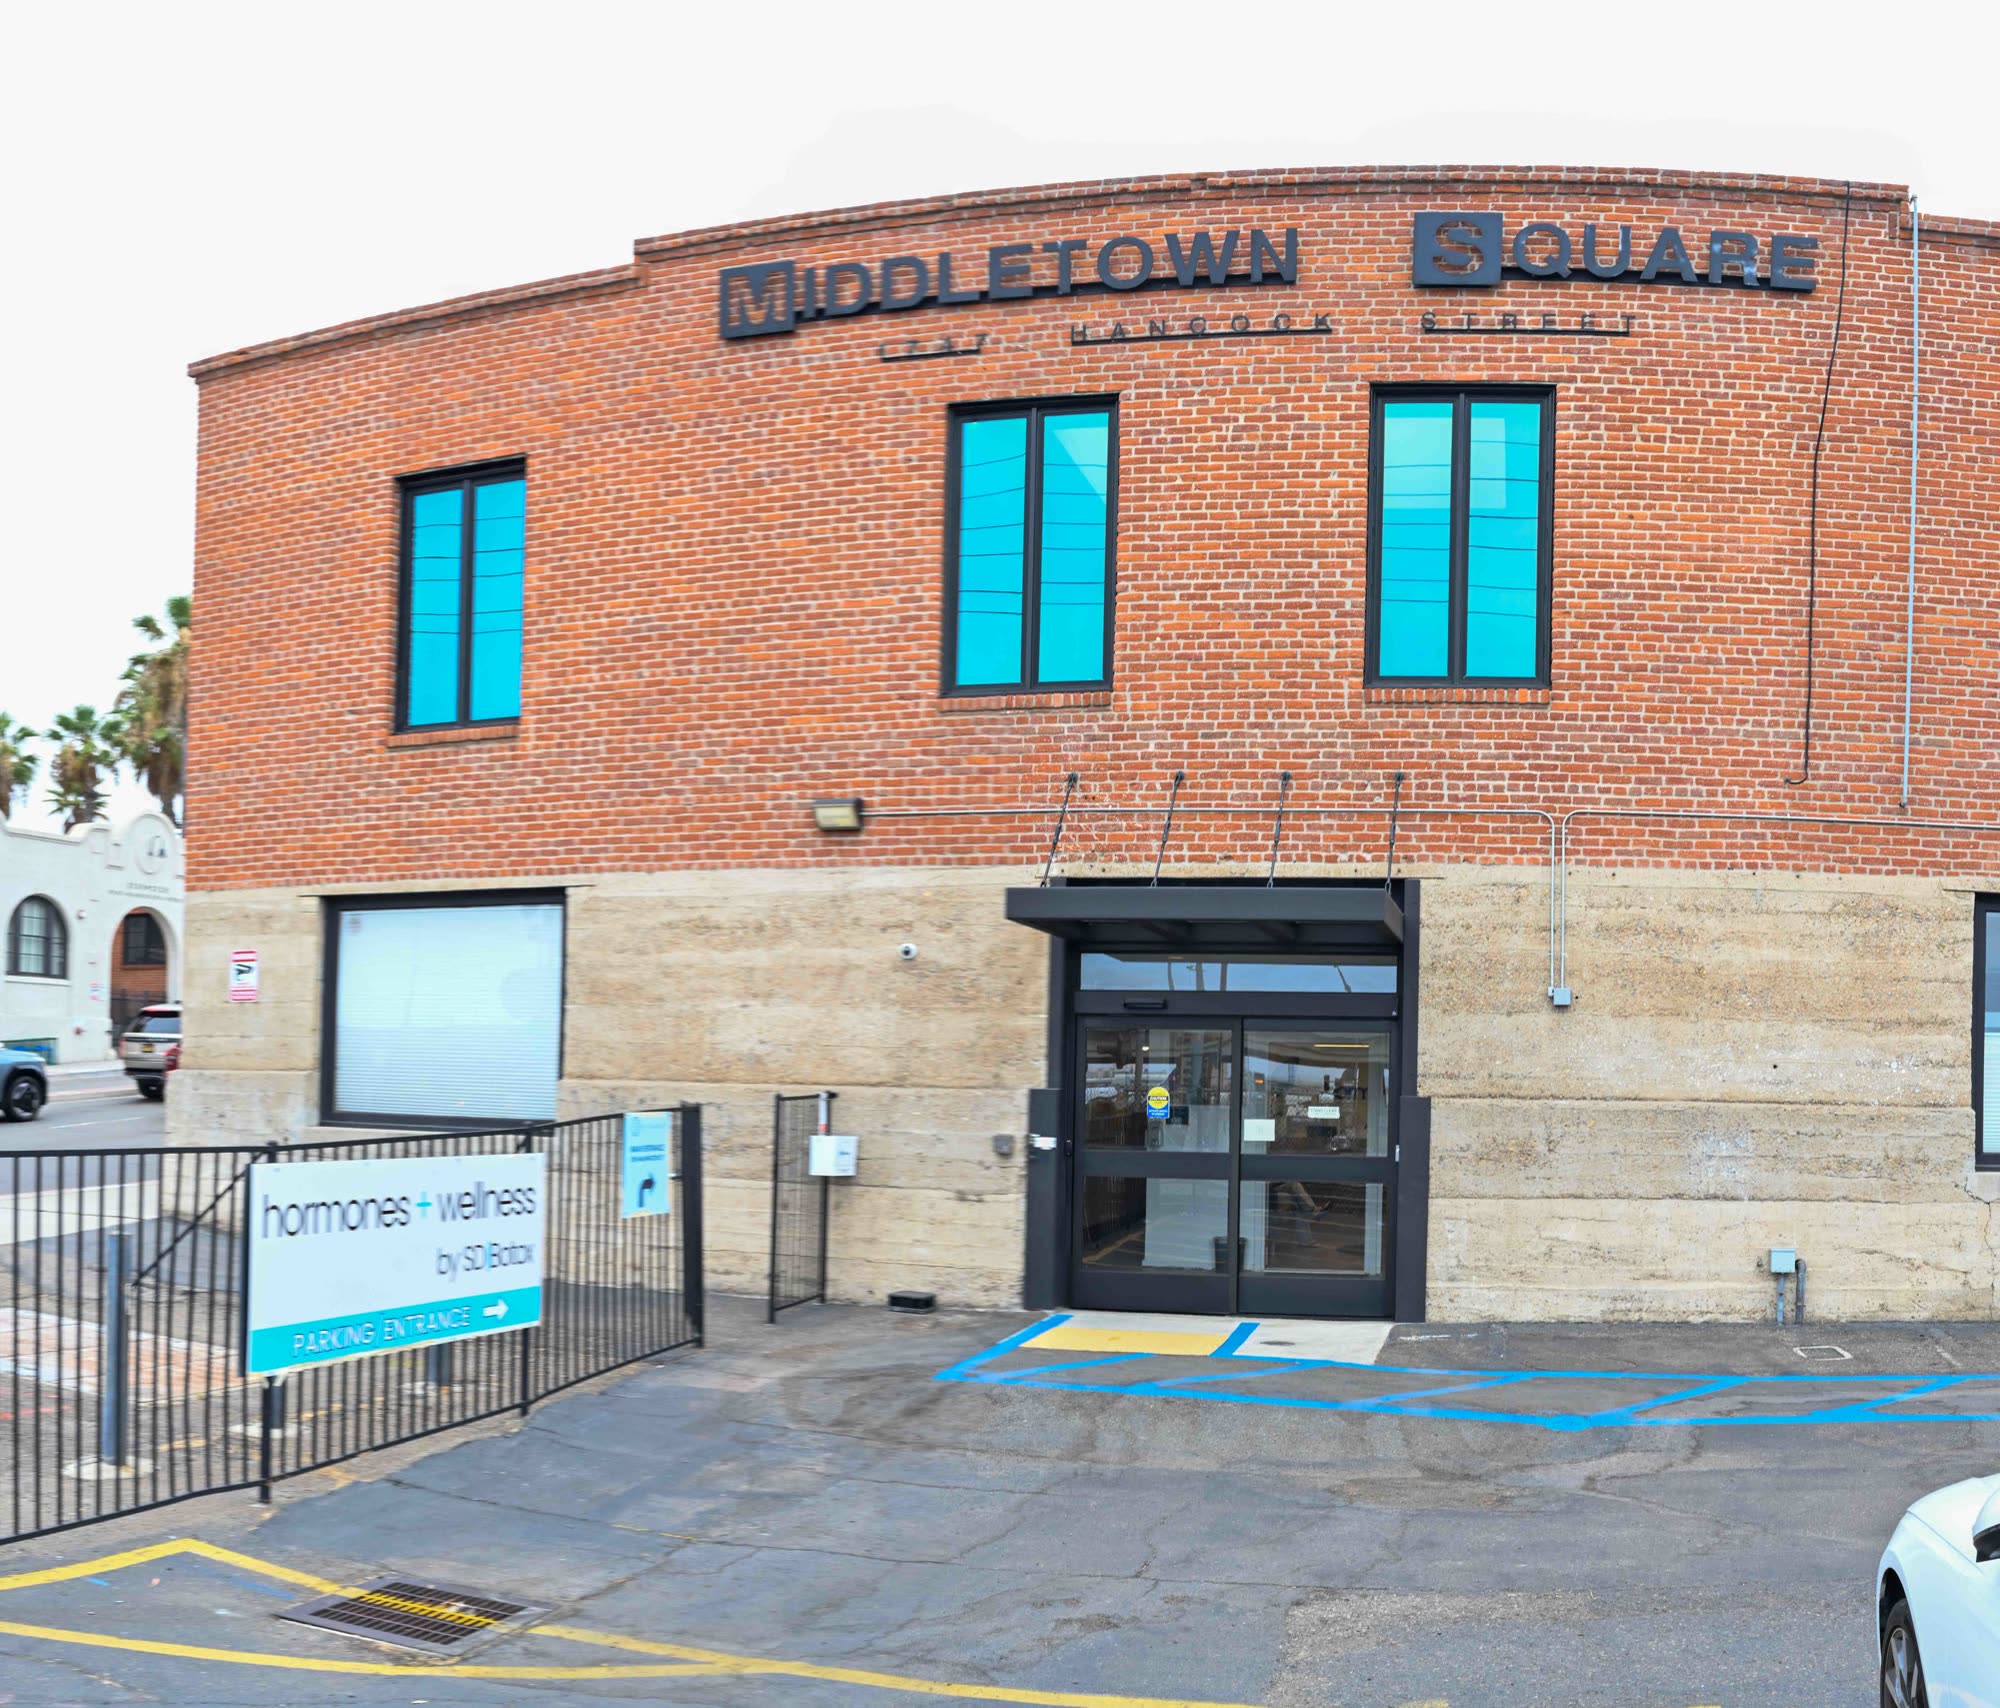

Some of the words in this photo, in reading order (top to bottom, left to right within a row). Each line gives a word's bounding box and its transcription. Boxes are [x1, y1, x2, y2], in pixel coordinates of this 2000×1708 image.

[720, 228, 1297, 339] MIDDLETOWN
[1412, 212, 1818, 292] SQUARE
[1071, 312, 1331, 342] HANCOCK
[1420, 312, 1636, 334] STREET
[262, 1195, 411, 1238] hormones
[436, 1181, 536, 1222] wellness
[436, 1247, 463, 1282] by
